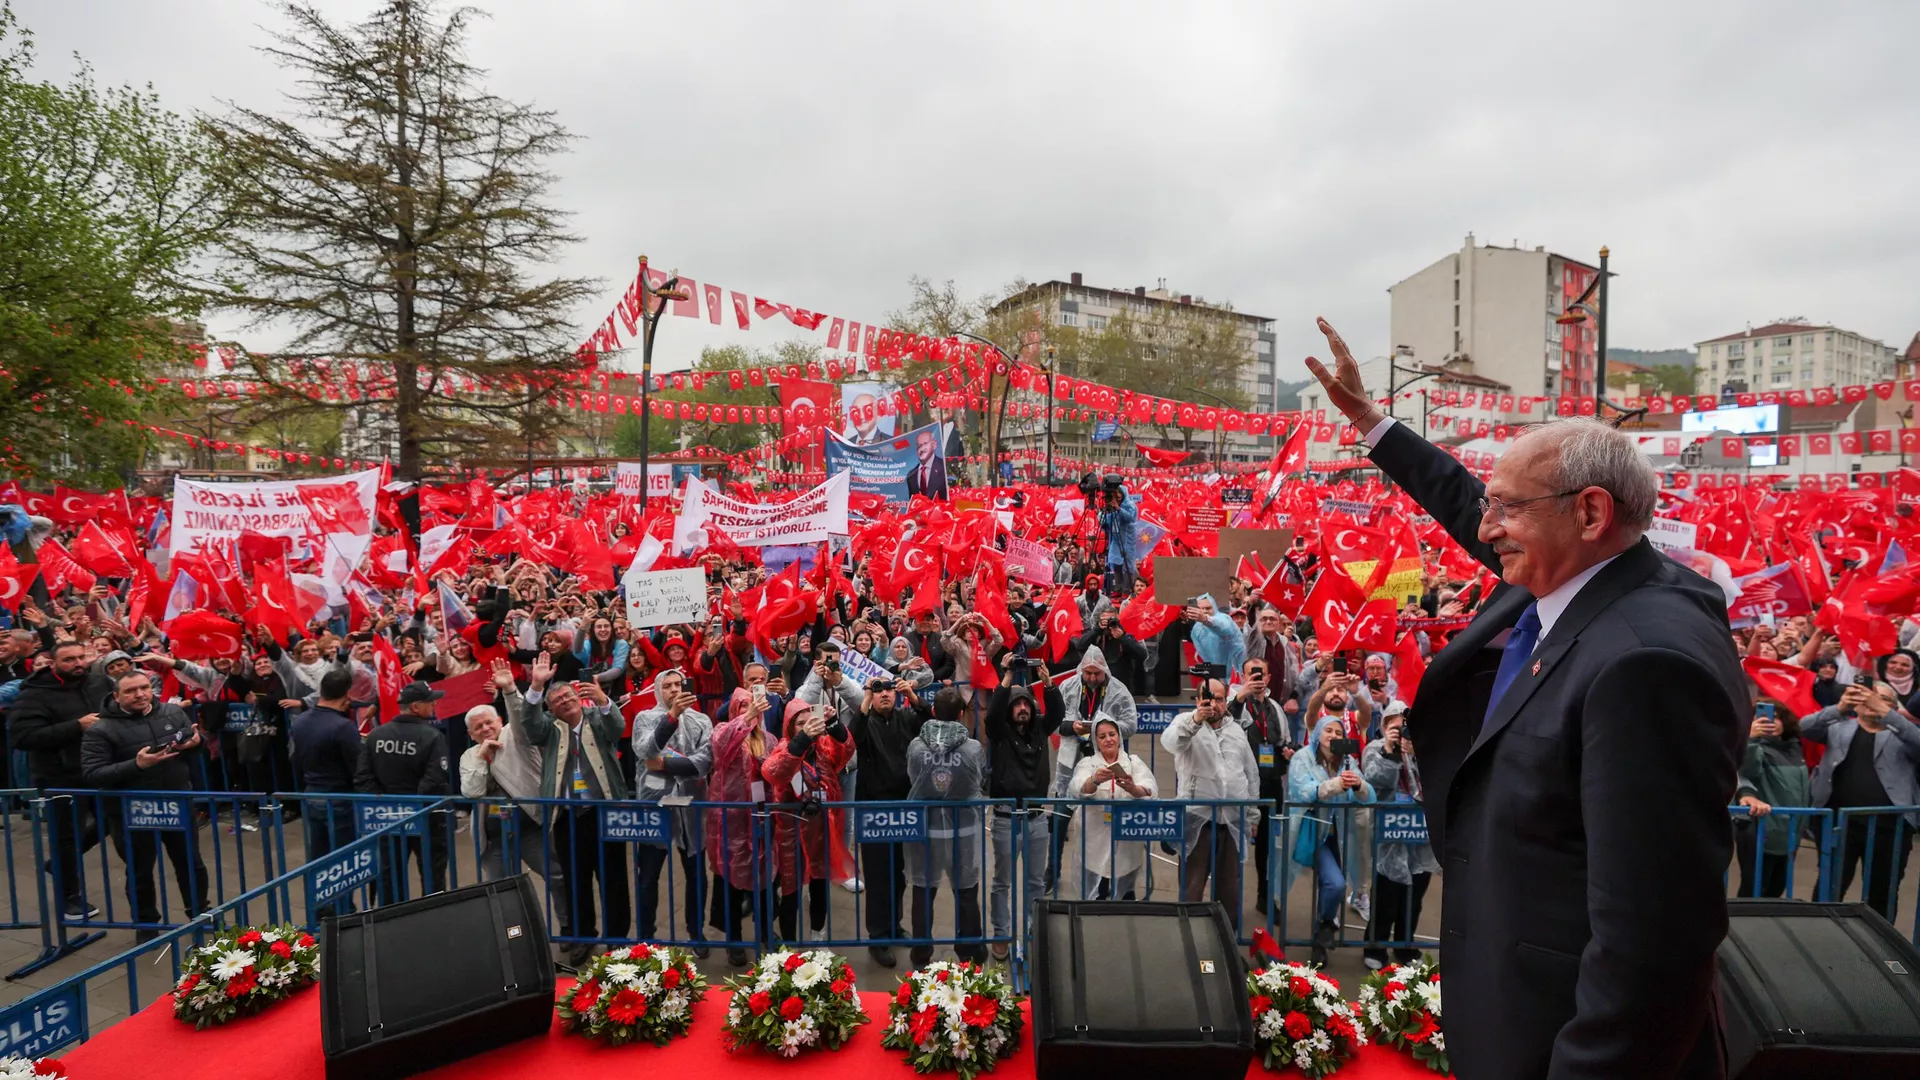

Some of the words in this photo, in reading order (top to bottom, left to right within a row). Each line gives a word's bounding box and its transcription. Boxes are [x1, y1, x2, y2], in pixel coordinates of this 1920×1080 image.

[606, 808, 662, 826] POLİS
[1120, 808, 1177, 825] POLİS
[315, 849, 373, 890] POLİS
[0, 1000, 70, 1052] OLİS
